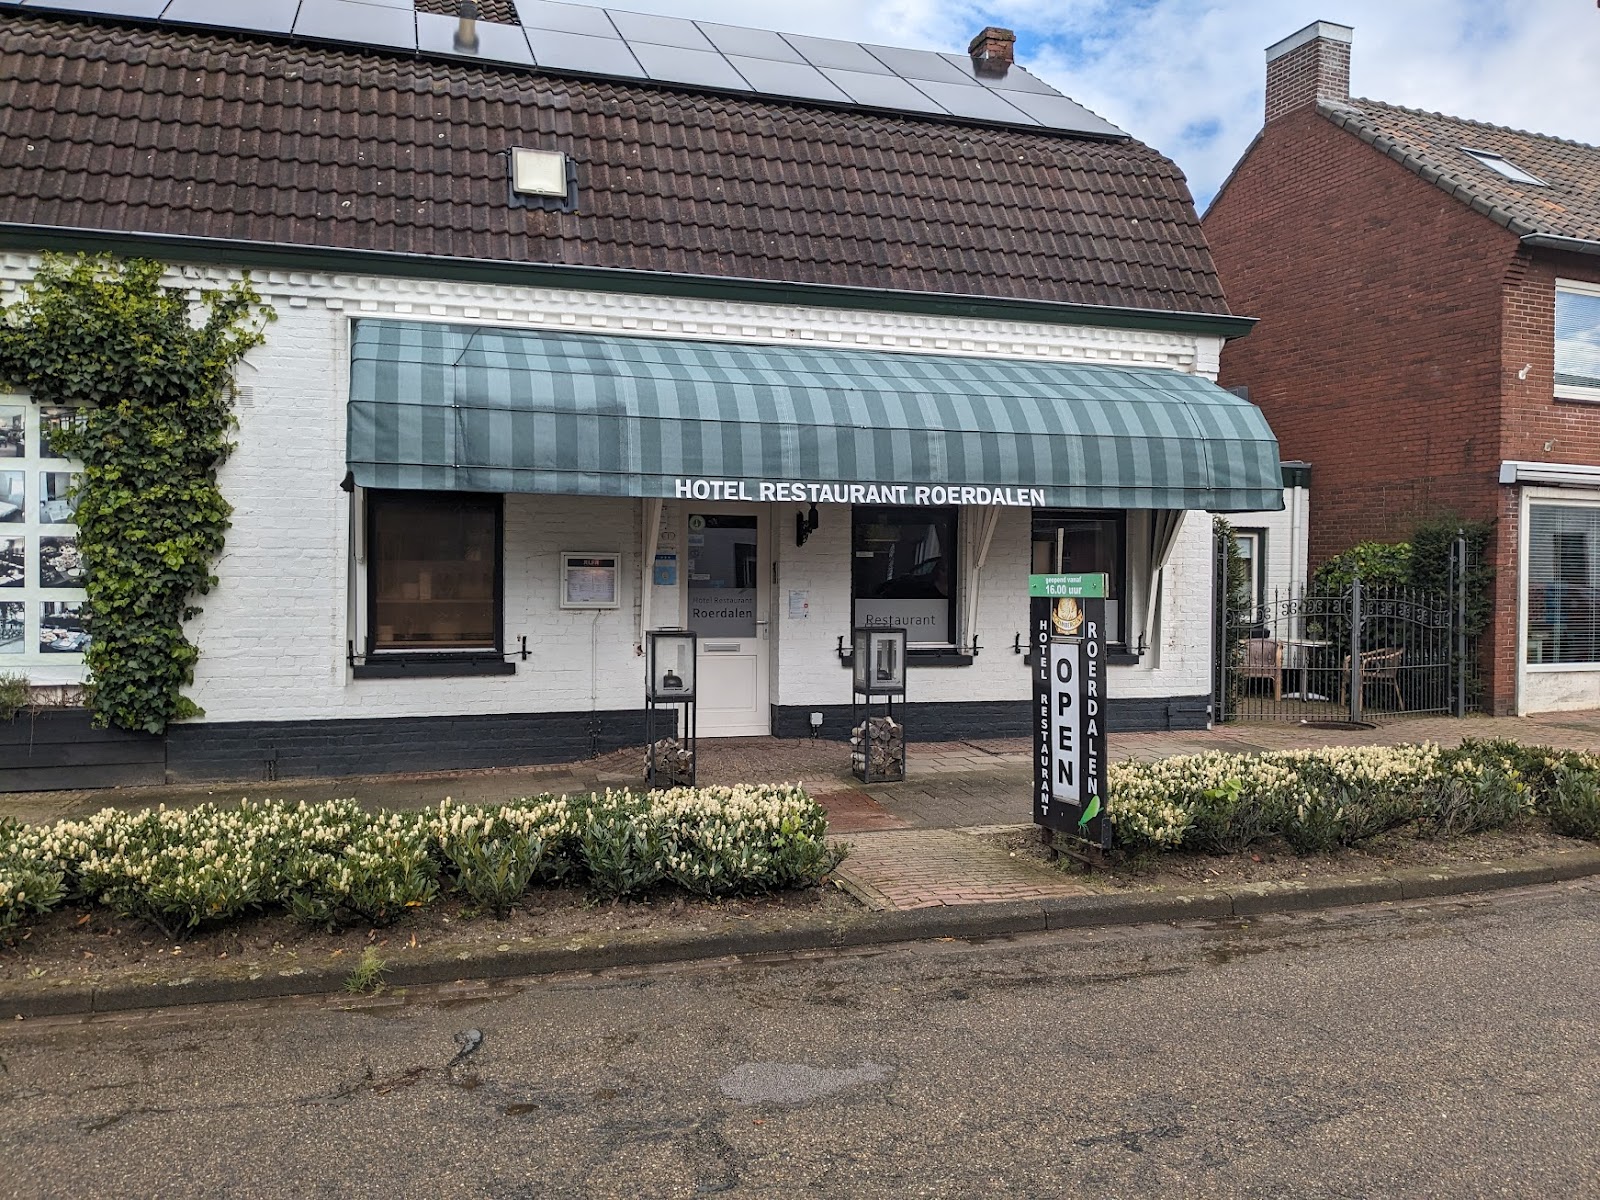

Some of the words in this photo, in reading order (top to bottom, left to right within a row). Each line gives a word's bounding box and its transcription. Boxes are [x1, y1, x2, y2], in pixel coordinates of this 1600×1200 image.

[675, 479, 752, 501] HOTEL
[759, 481, 908, 505] RESTAURANT
[914, 486, 1045, 507] ROERDALEN
[693, 596, 712, 604] Hotel
[714, 596, 753, 604] Restaurant
[1045, 585, 1067, 594] 16.00
[693, 608, 753, 619] Roerdalen
[866, 614, 936, 626] Restaurant
[1039, 620, 1048, 680] HOTEL
[1056, 658, 1073, 786] OPEN
[1087, 621, 1098, 795] ROERDALEN
[1041, 694, 1049, 816] RESTAURANT
